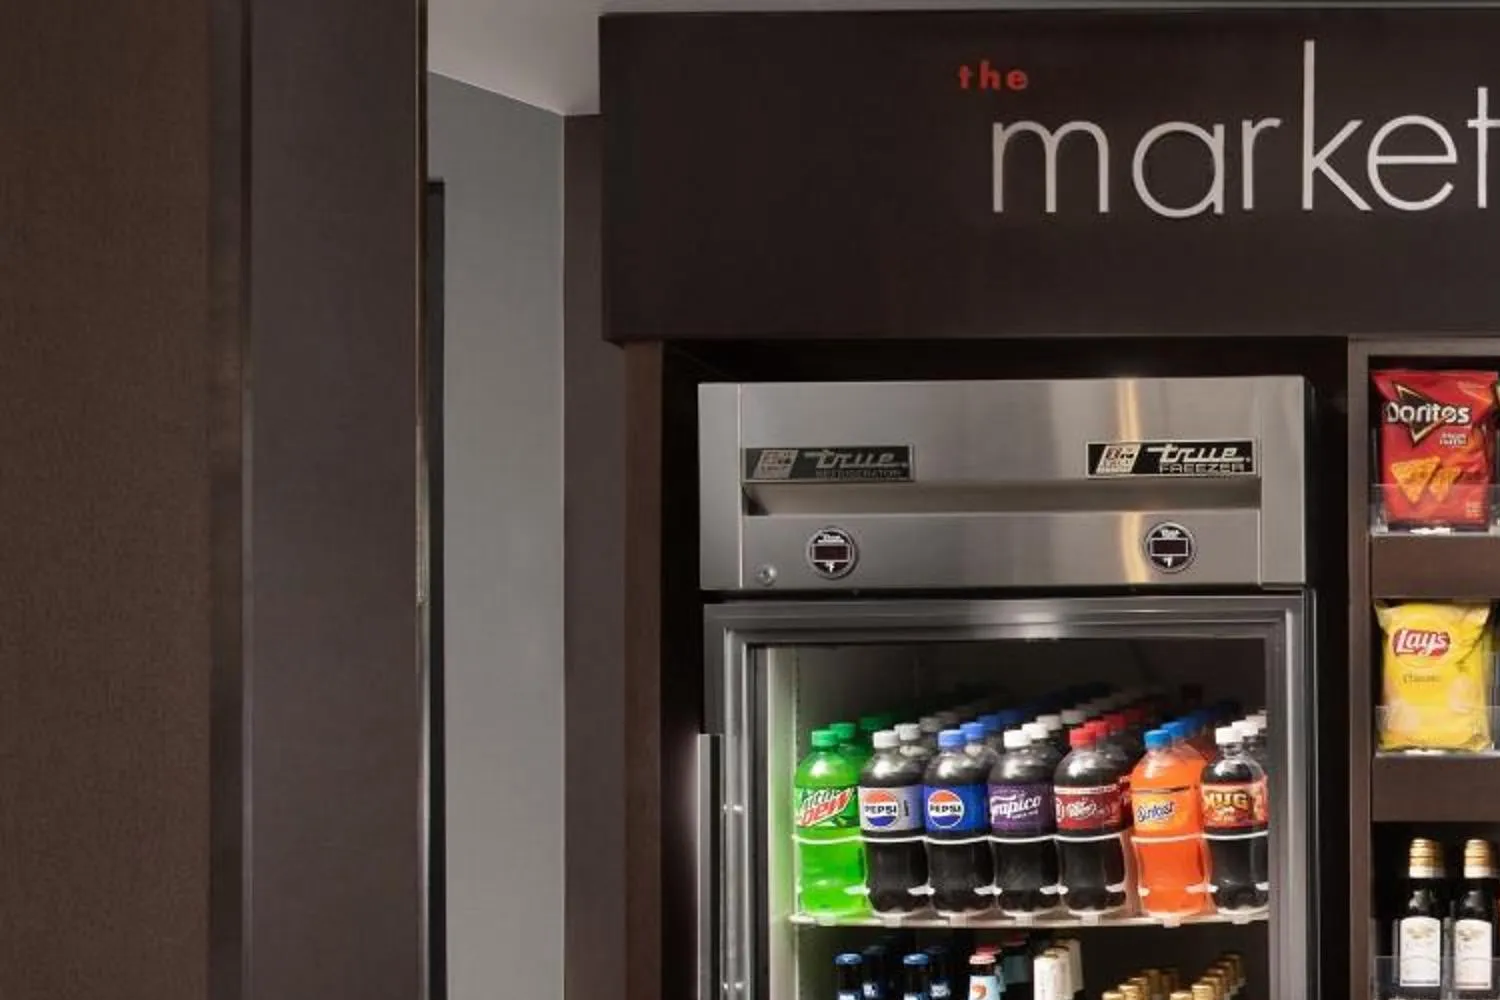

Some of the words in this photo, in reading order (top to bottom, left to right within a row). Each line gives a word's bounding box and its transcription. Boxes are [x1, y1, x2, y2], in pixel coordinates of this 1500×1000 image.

[958, 61, 1029, 91] the
[1385, 402, 1471, 425] Doritos
[1147, 444, 1245, 462] true
[1395, 629, 1450, 656] Lay's
[864, 805, 897, 814] PEPSI
[929, 805, 962, 814] PEPSI
